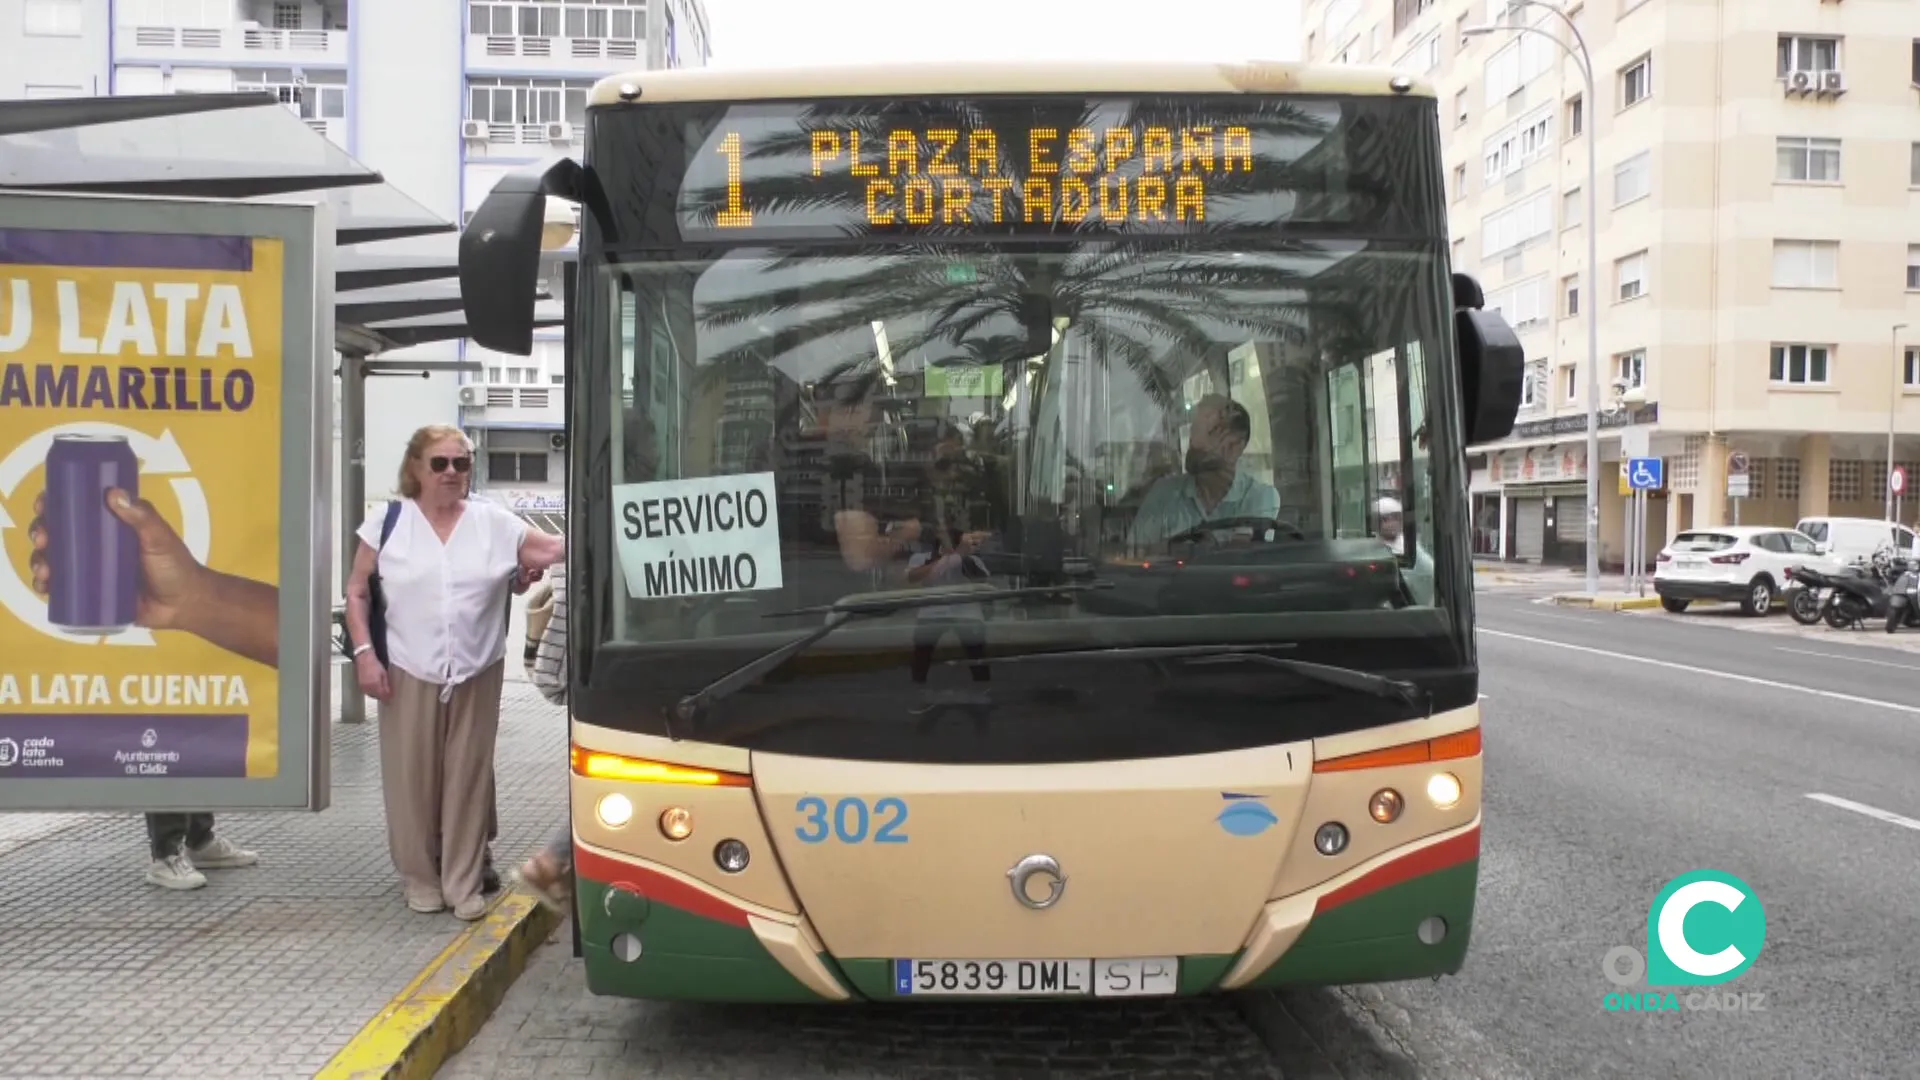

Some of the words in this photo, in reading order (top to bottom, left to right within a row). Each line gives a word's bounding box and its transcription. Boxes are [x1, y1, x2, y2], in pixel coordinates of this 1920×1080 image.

[811, 128, 995, 177] PLAZA
[1030, 126, 1253, 173] ESPAÑA
[716, 131, 752, 227] 1
[866, 176, 1206, 225] CORTADURA
[57, 280, 253, 358] LATA
[0, 363, 255, 412] AMARILLO
[623, 488, 768, 540] SERVICIO
[644, 550, 757, 596] MÍNIMO
[31, 674, 111, 705] LATA
[119, 674, 249, 706] CUENTA
[22, 747, 46, 757] lata
[22, 757, 64, 766] cuenta
[24, 736, 55, 747] cada
[114, 750, 179, 764] Ayuntamiento
[125, 764, 138, 774] de
[795, 797, 909, 844] 302
[917, 961, 1005, 991] 5839
[1018, 962, 1081, 991] DML
